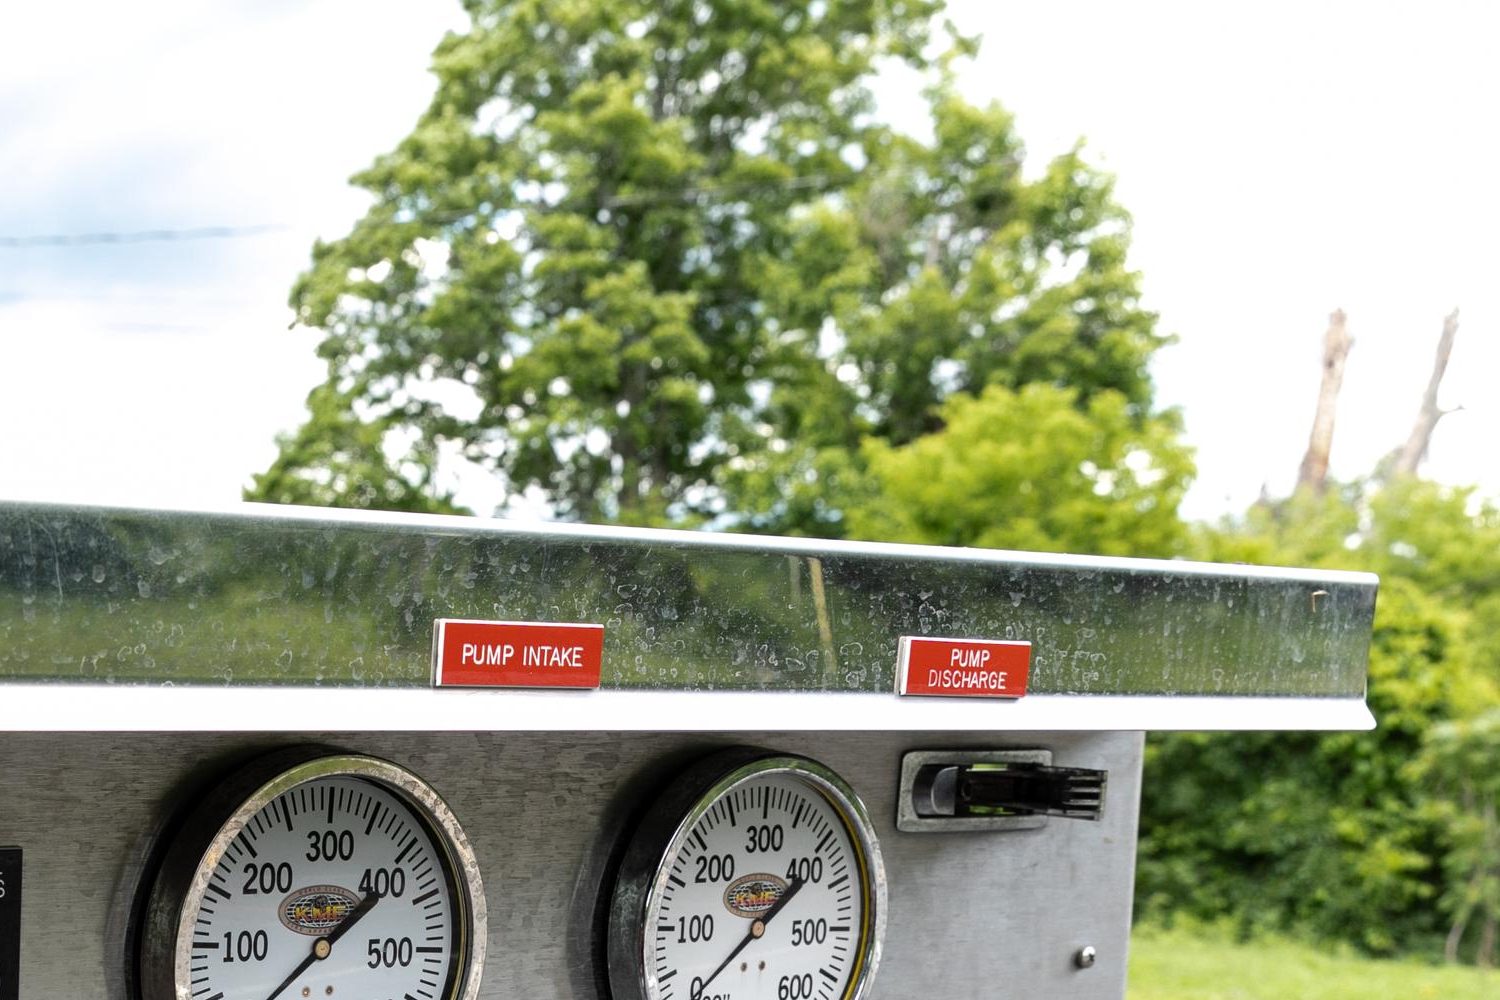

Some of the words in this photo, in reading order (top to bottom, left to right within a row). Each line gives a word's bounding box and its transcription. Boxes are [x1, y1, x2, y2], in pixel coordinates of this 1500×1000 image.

[461, 643, 514, 666] PUMP
[522, 645, 583, 669] INTAKE
[950, 648, 990, 669] PUMP
[927, 668, 1008, 691] DISCHARGE
[306, 830, 354, 862] 300
[745, 824, 784, 853] 300
[242, 861, 293, 895] 200
[358, 866, 405, 898] 400
[694, 854, 735, 884] 200
[786, 856, 823, 885] 400
[677, 914, 714, 944] 100
[791, 918, 827, 947] 500
[223, 929, 268, 963] 100
[367, 936, 412, 969] 500
